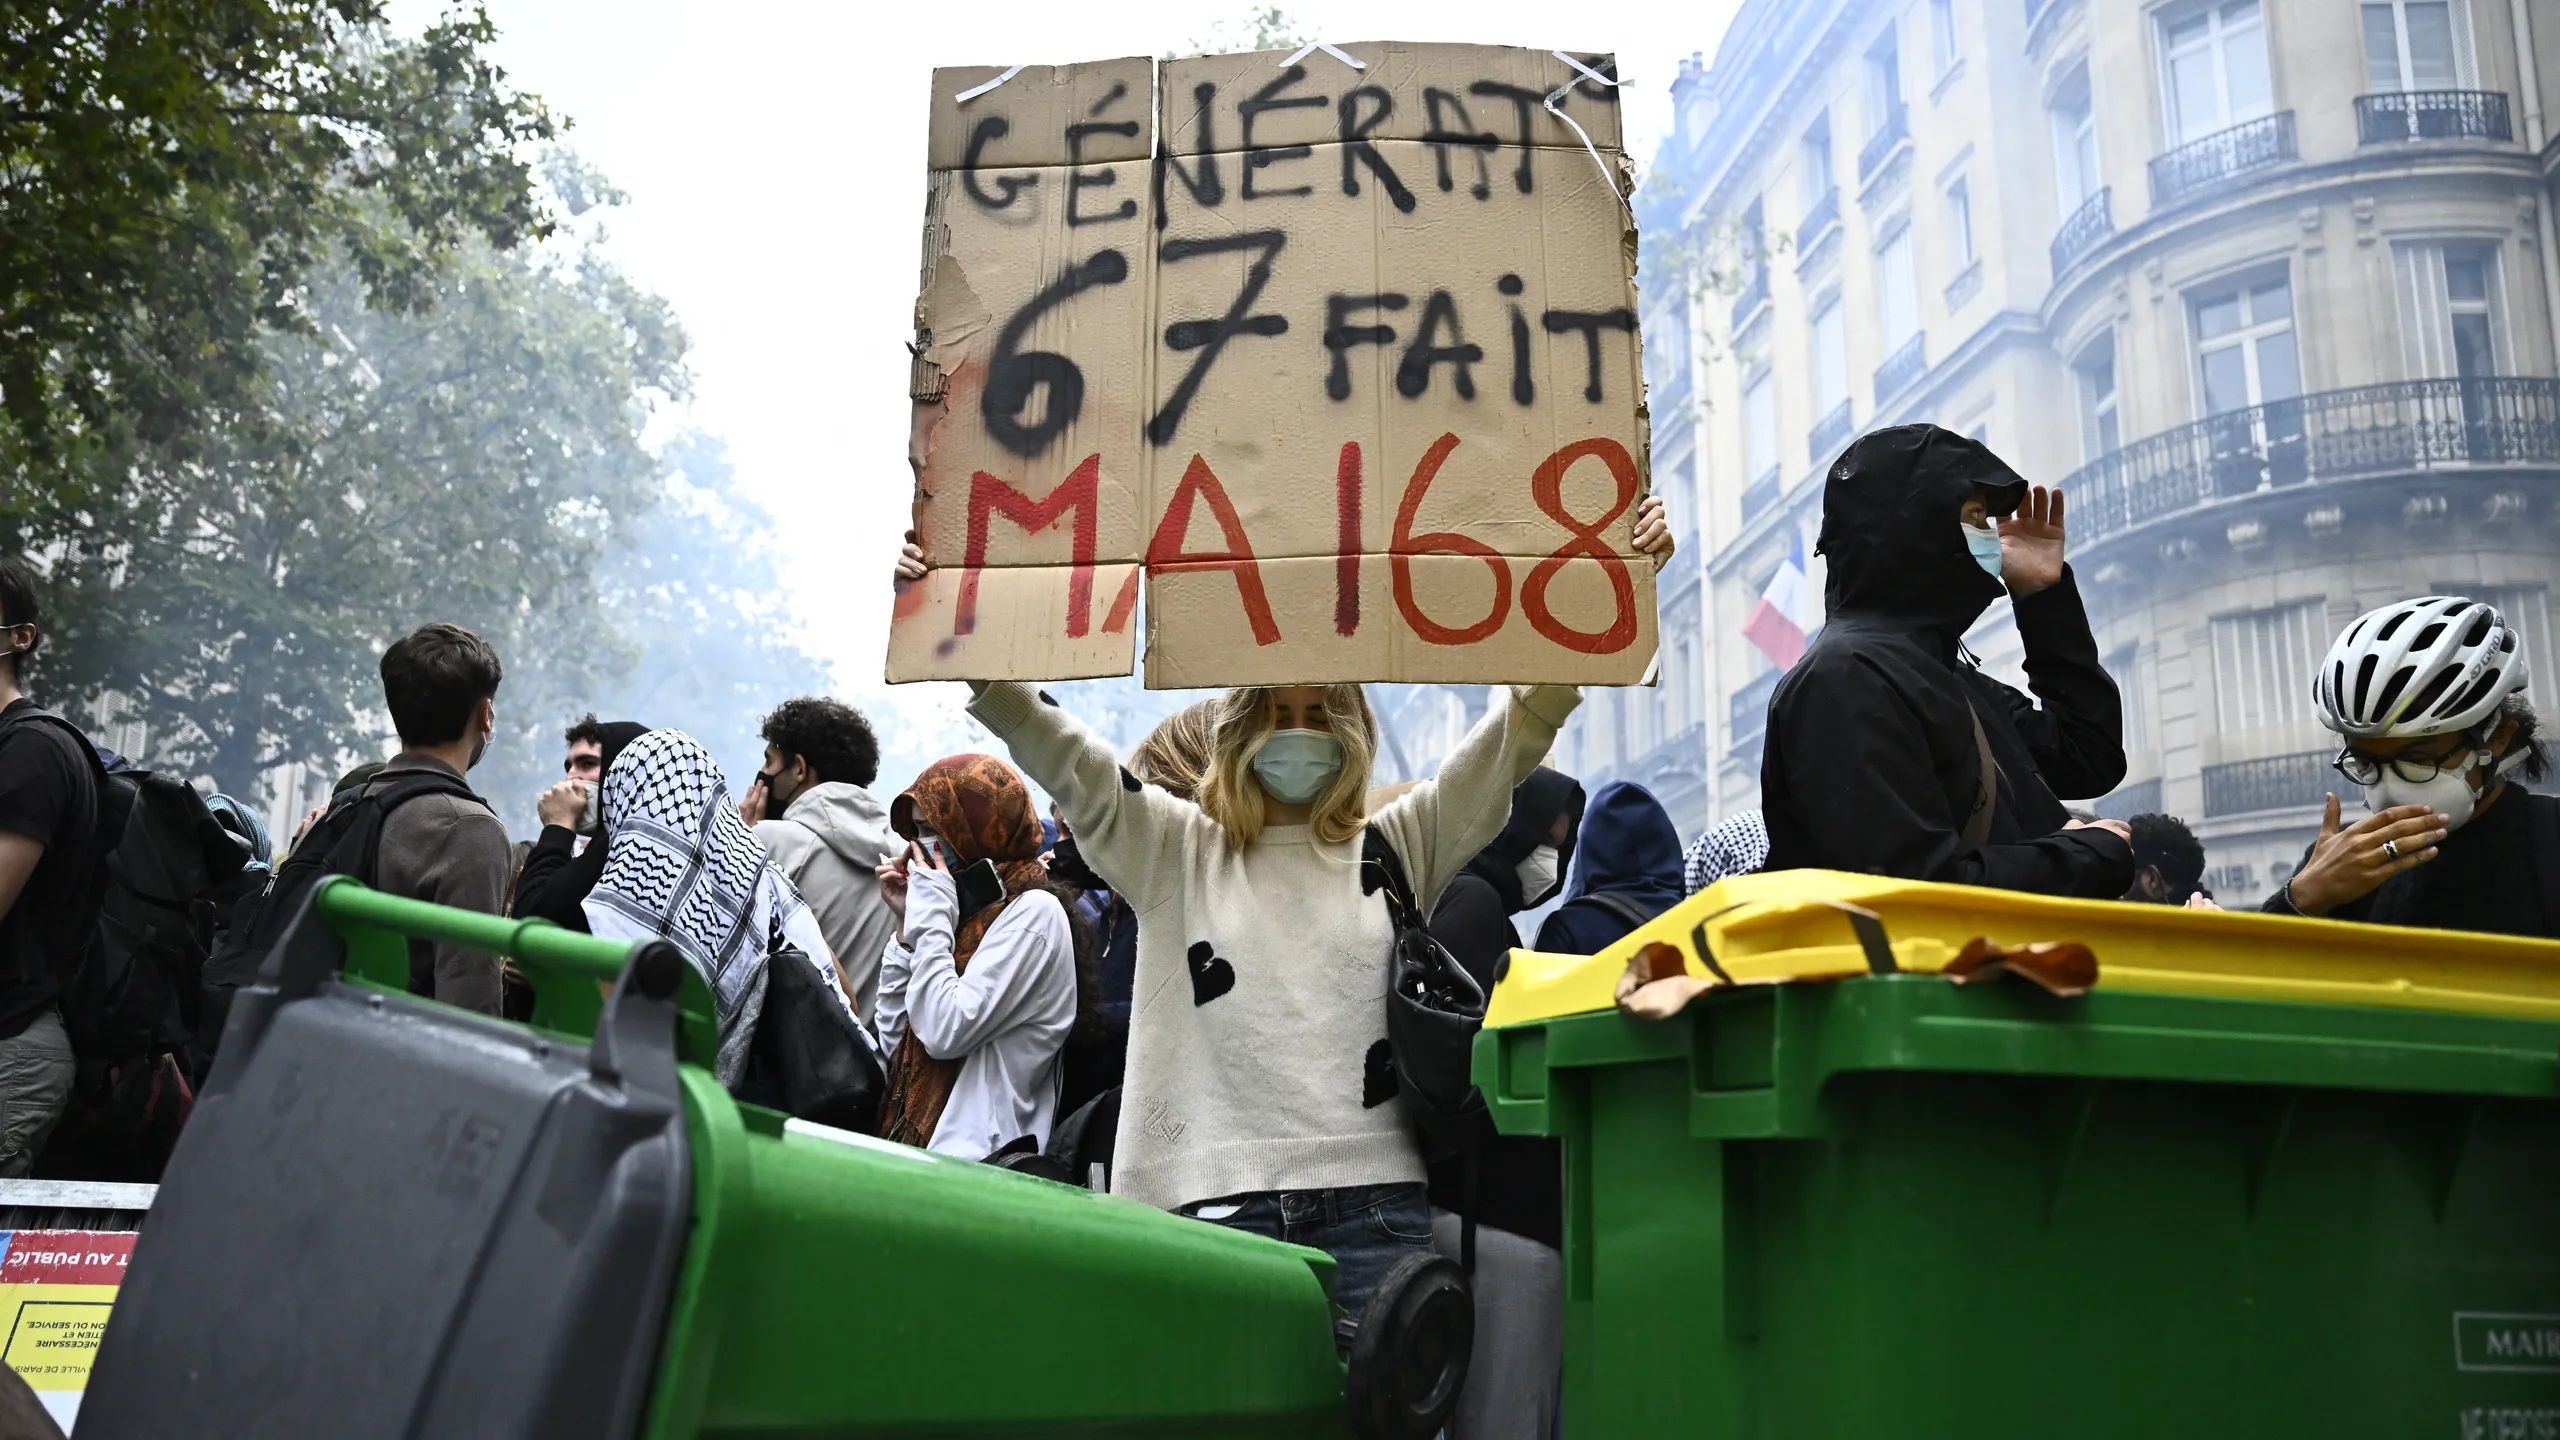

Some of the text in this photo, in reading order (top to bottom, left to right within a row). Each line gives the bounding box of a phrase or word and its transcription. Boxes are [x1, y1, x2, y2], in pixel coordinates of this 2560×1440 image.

[981, 230, 1288, 460] 67
[955, 433, 1639, 654] MAI 68
[11, 1251, 81, 1266] PUBLIC
[85, 1252, 115, 1266] AU
[26, 1321, 71, 1329] SERVICE.
[62, 1331, 75, 1339] ET
[35, 1340, 98, 1349] NÉCESSAIRE
[14, 1365, 42, 1373] PARIS
[61, 1366, 86, 1374] VILLE
